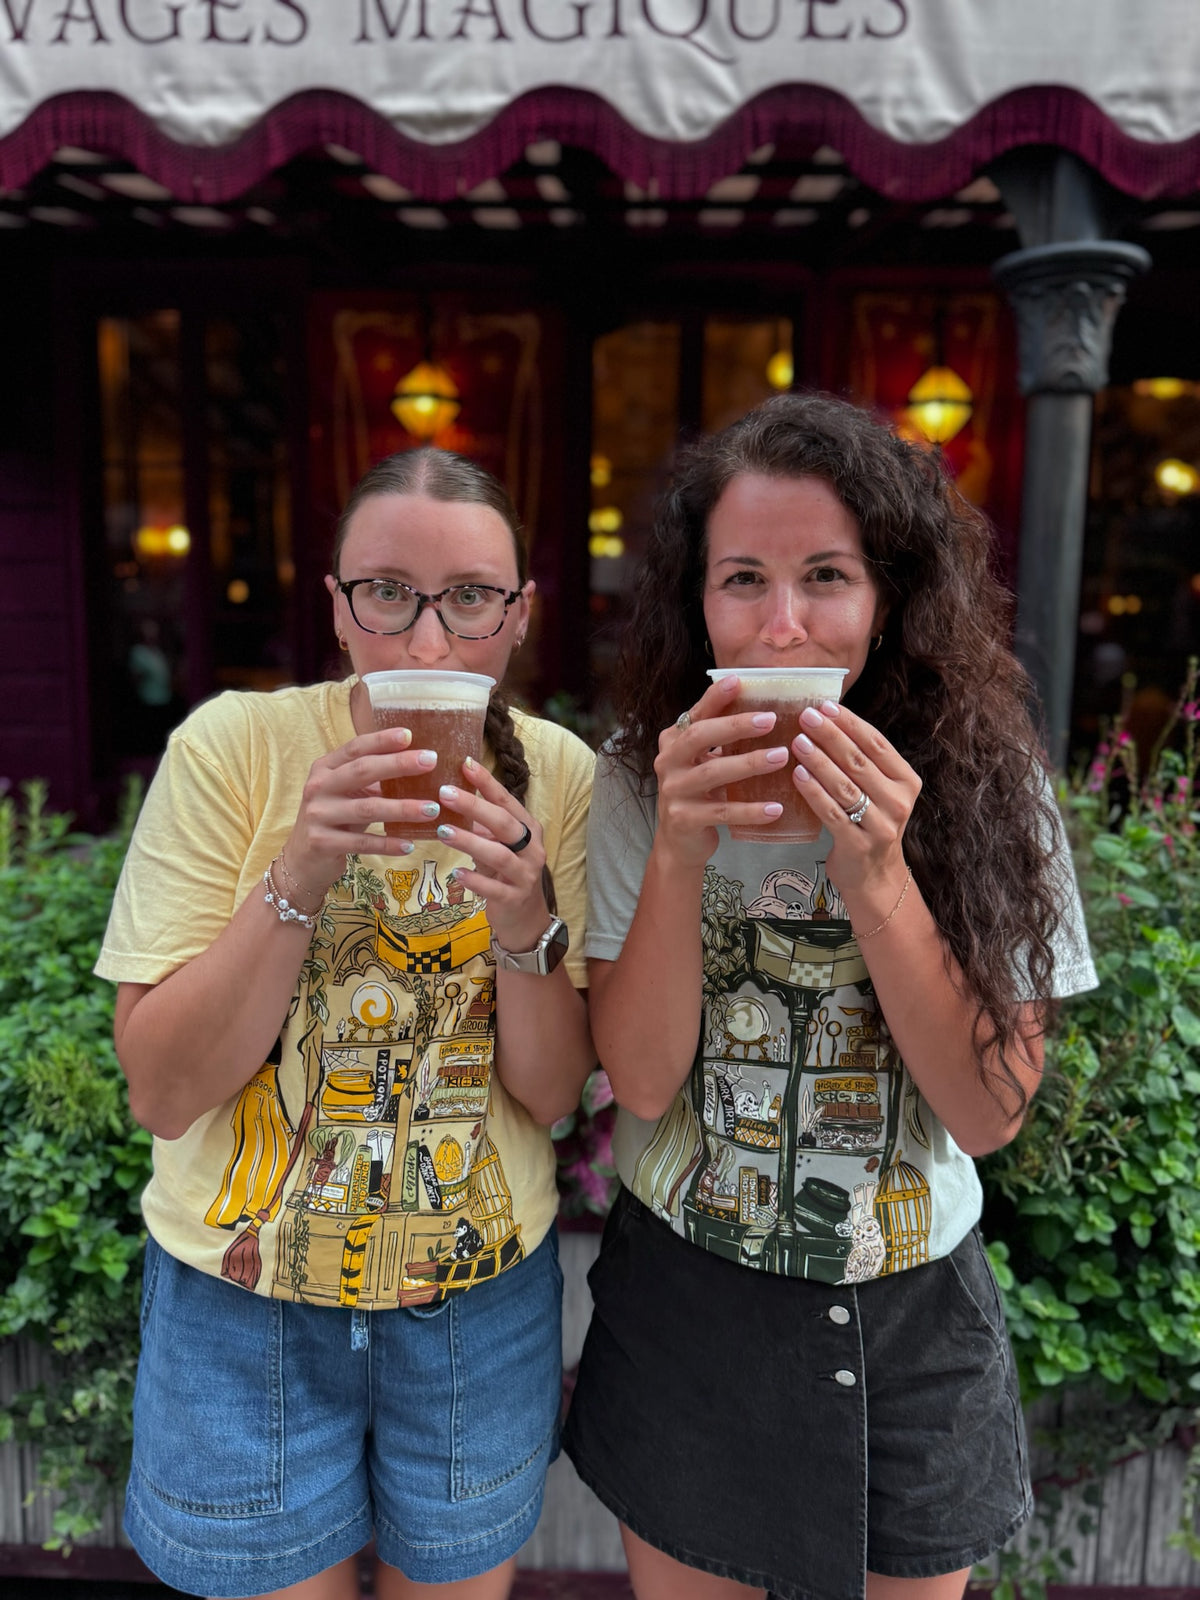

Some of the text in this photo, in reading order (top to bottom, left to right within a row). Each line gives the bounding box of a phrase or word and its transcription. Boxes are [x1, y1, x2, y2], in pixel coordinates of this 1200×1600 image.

[355, 0, 908, 64] MAGIQUES
[717, 1079, 735, 1128] DARK ARTS
[358, 1161, 370, 1208] AND FUNGI
[420, 1162, 437, 1203] DARK ARTS
